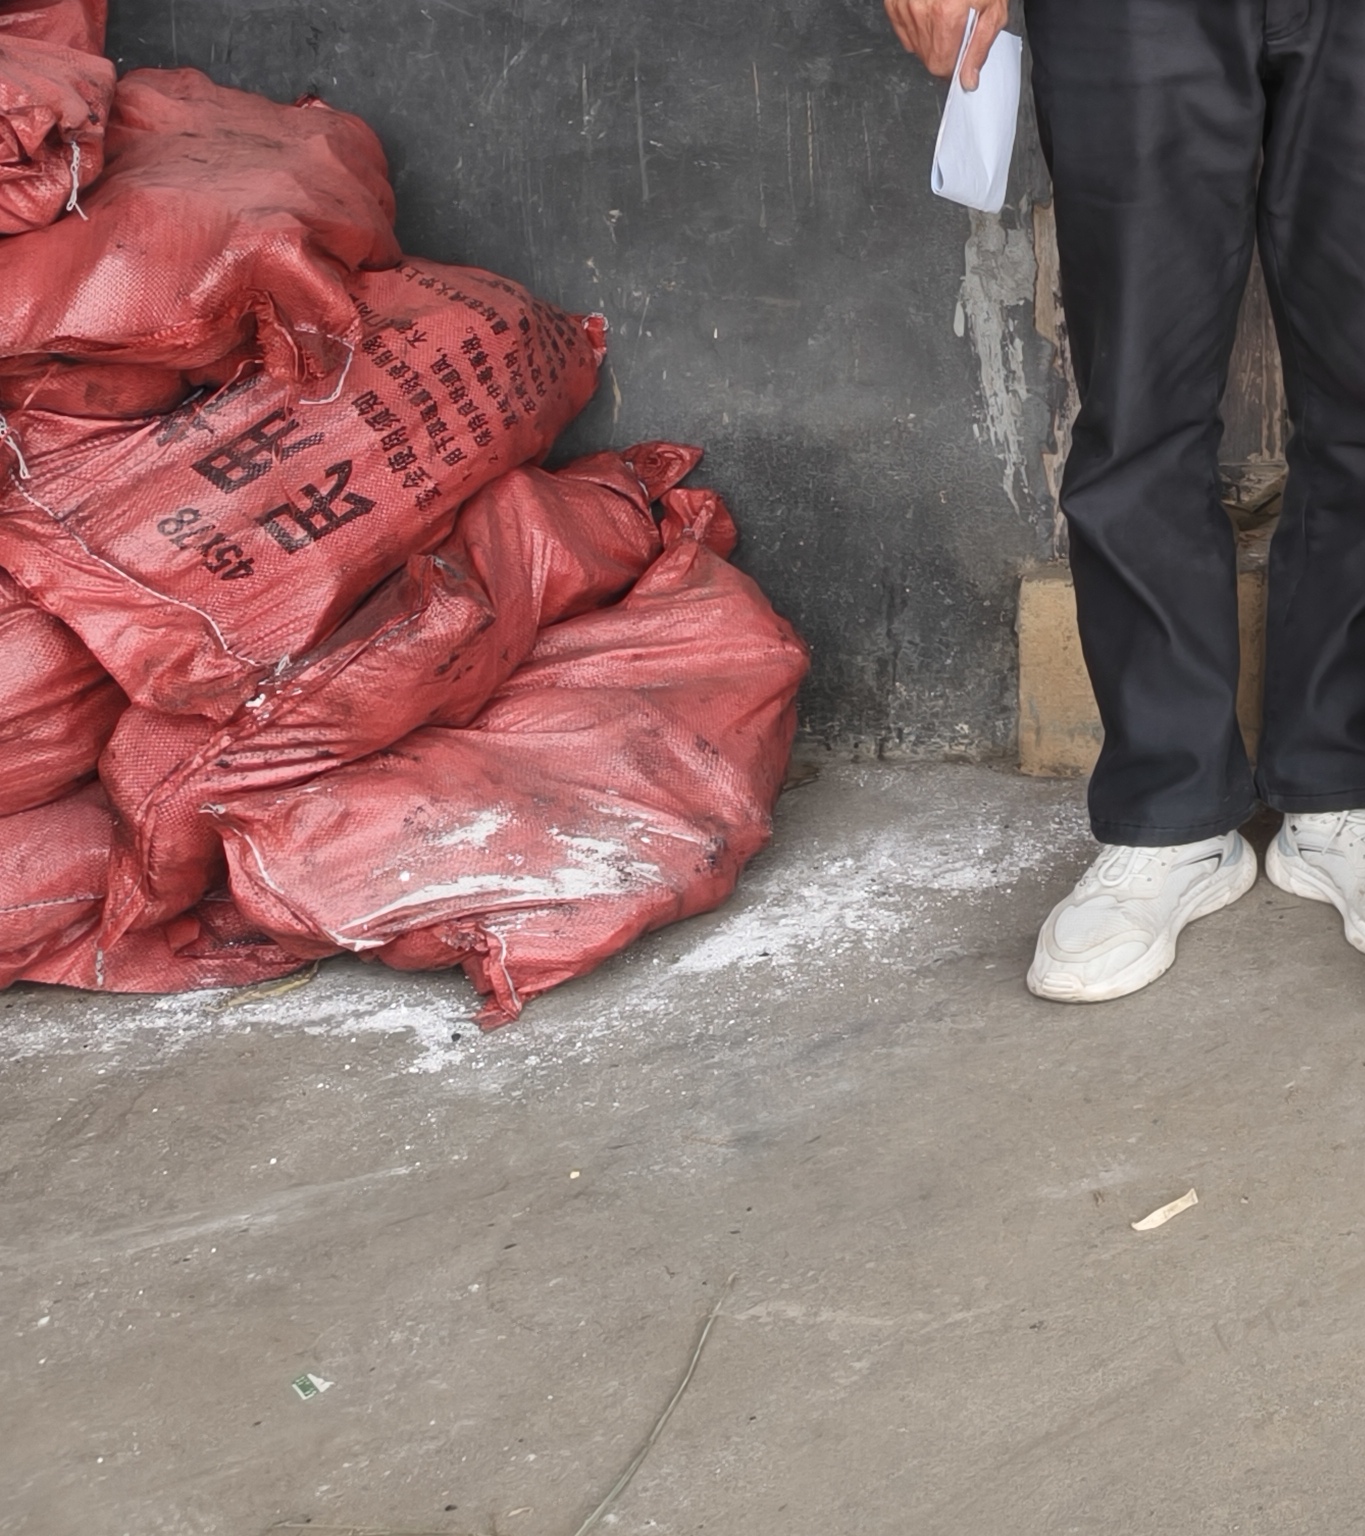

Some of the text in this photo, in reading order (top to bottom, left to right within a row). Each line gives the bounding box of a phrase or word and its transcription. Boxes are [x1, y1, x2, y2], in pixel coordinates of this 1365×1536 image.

[353, 389, 442, 512] 安全使用须知
